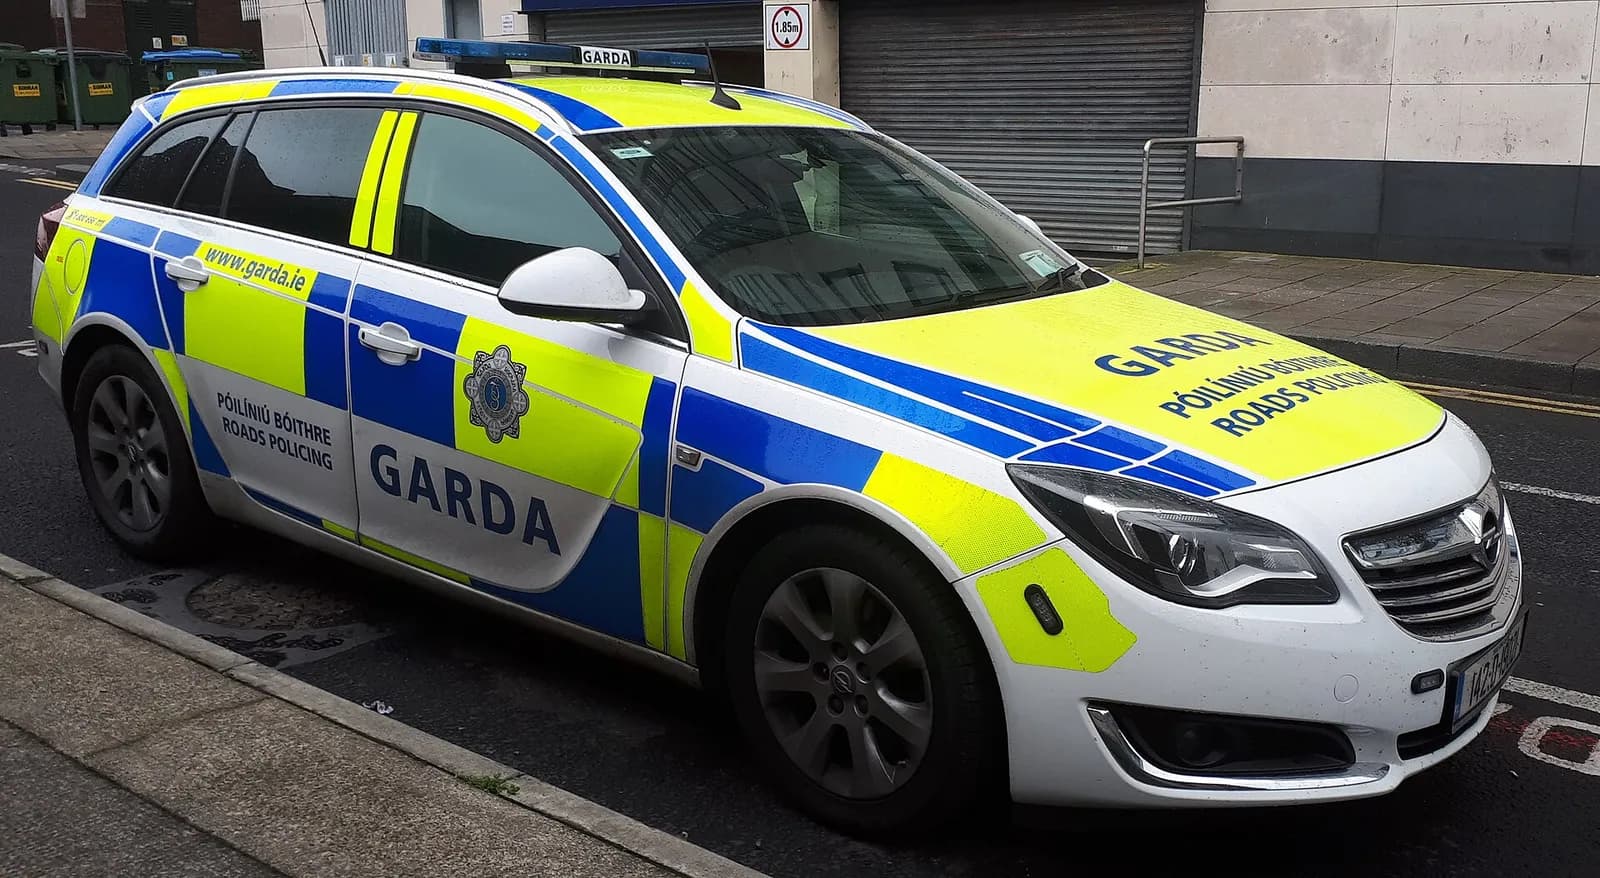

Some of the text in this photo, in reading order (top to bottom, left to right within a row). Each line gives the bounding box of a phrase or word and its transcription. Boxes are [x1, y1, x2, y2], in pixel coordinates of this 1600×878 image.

[775, 21, 799, 33] 1.85m
[583, 50, 630, 65] GARDA
[205, 247, 306, 291] www.garda.ie
[1094, 331, 1273, 376] GARDA
[1159, 365, 1275, 419] PÓILÍNIÚ
[1210, 371, 1389, 437] ROADS POLICING
[217, 392, 332, 447] PÓILÍNIÚ BÓITHRE
[222, 416, 333, 471] ROADS POLICING
[370, 444, 561, 556] GARDA
